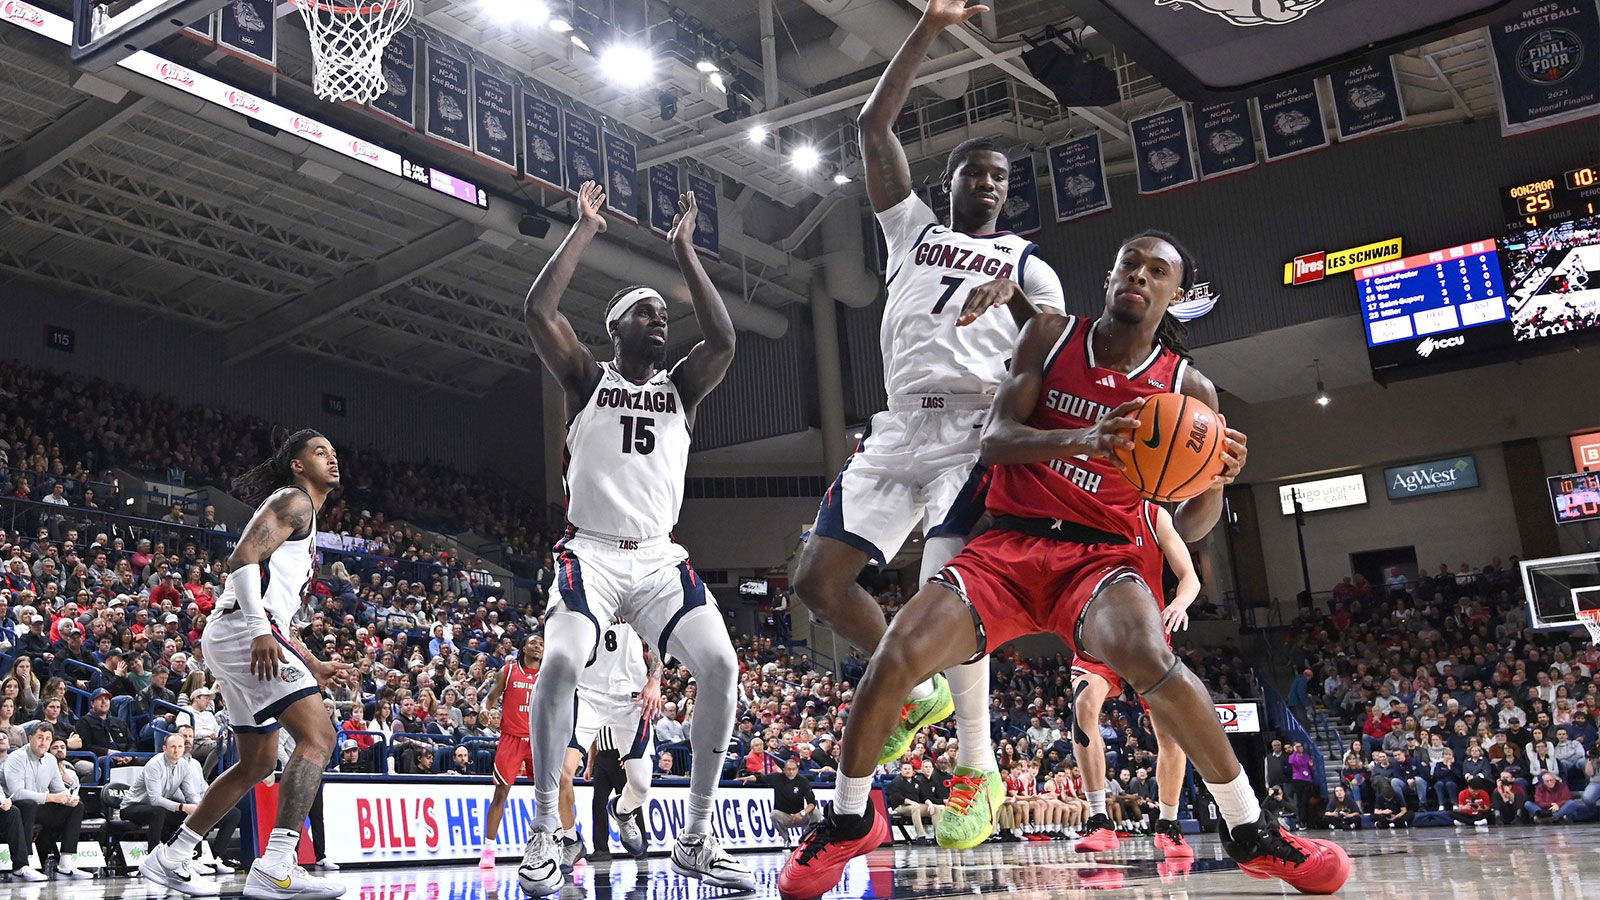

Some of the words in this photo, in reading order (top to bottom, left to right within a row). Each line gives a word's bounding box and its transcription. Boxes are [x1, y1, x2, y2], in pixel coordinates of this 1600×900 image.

[1522, 3, 1559, 19] MEN'S
[1504, 7, 1580, 33] BASKETBALL
[1528, 41, 1568, 60] FINAL
[1532, 53, 1570, 73] FOUR
[438, 68, 459, 83] NCAA
[1349, 65, 1373, 78] NCAA
[431, 74, 444, 86] 2nd
[444, 80, 467, 96] Round
[484, 90, 504, 104] NCAA
[1275, 87, 1299, 100] NCAA
[1547, 89, 1569, 100] 2021
[477, 96, 491, 107] 2nd
[490, 102, 512, 117] Round
[1263, 100, 1286, 111] Sweet
[1286, 92, 1314, 104] Sixteen
[1528, 101, 1562, 116] National
[1563, 93, 1594, 106] Finalist
[1204, 118, 1221, 129] Elite
[1221, 112, 1241, 125] Eight
[1210, 108, 1232, 119] NCAA
[1148, 126, 1171, 138] NCAA
[1158, 130, 1182, 143] Round
[1510, 179, 1555, 198] GONZAGA
[1526, 193, 1551, 213] 25
[1587, 202, 1594, 214] 1
[1525, 215, 1537, 227] 4
[1548, 209, 1572, 221] FOULS
[915, 243, 1014, 280] GONZAGA
[1328, 257, 1347, 270] LES
[1348, 243, 1399, 265] SCHWAB
[1294, 259, 1325, 278] Tires
[1460, 267, 1467, 275] 0
[1374, 270, 1419, 285] Grant-Foster
[1485, 280, 1492, 288] 0
[930, 275, 966, 315] 7
[1486, 288, 1494, 296] 0
[53, 332, 70, 346] 115
[1147, 378, 1167, 390] WAC
[596, 387, 677, 414] GONZAGA
[921, 397, 945, 409] ZAGS
[619, 415, 656, 455] 15
[1186, 412, 1209, 454] ZAGS
[1392, 467, 1458, 491] AgWest
[1322, 482, 1362, 497] URGENT
[1324, 493, 1349, 504] CARE
[619, 539, 639, 550] ZAGS
[604, 629, 618, 652] 8
[356, 797, 440, 849] BILL'S
[78, 850, 98, 858] ICCU
